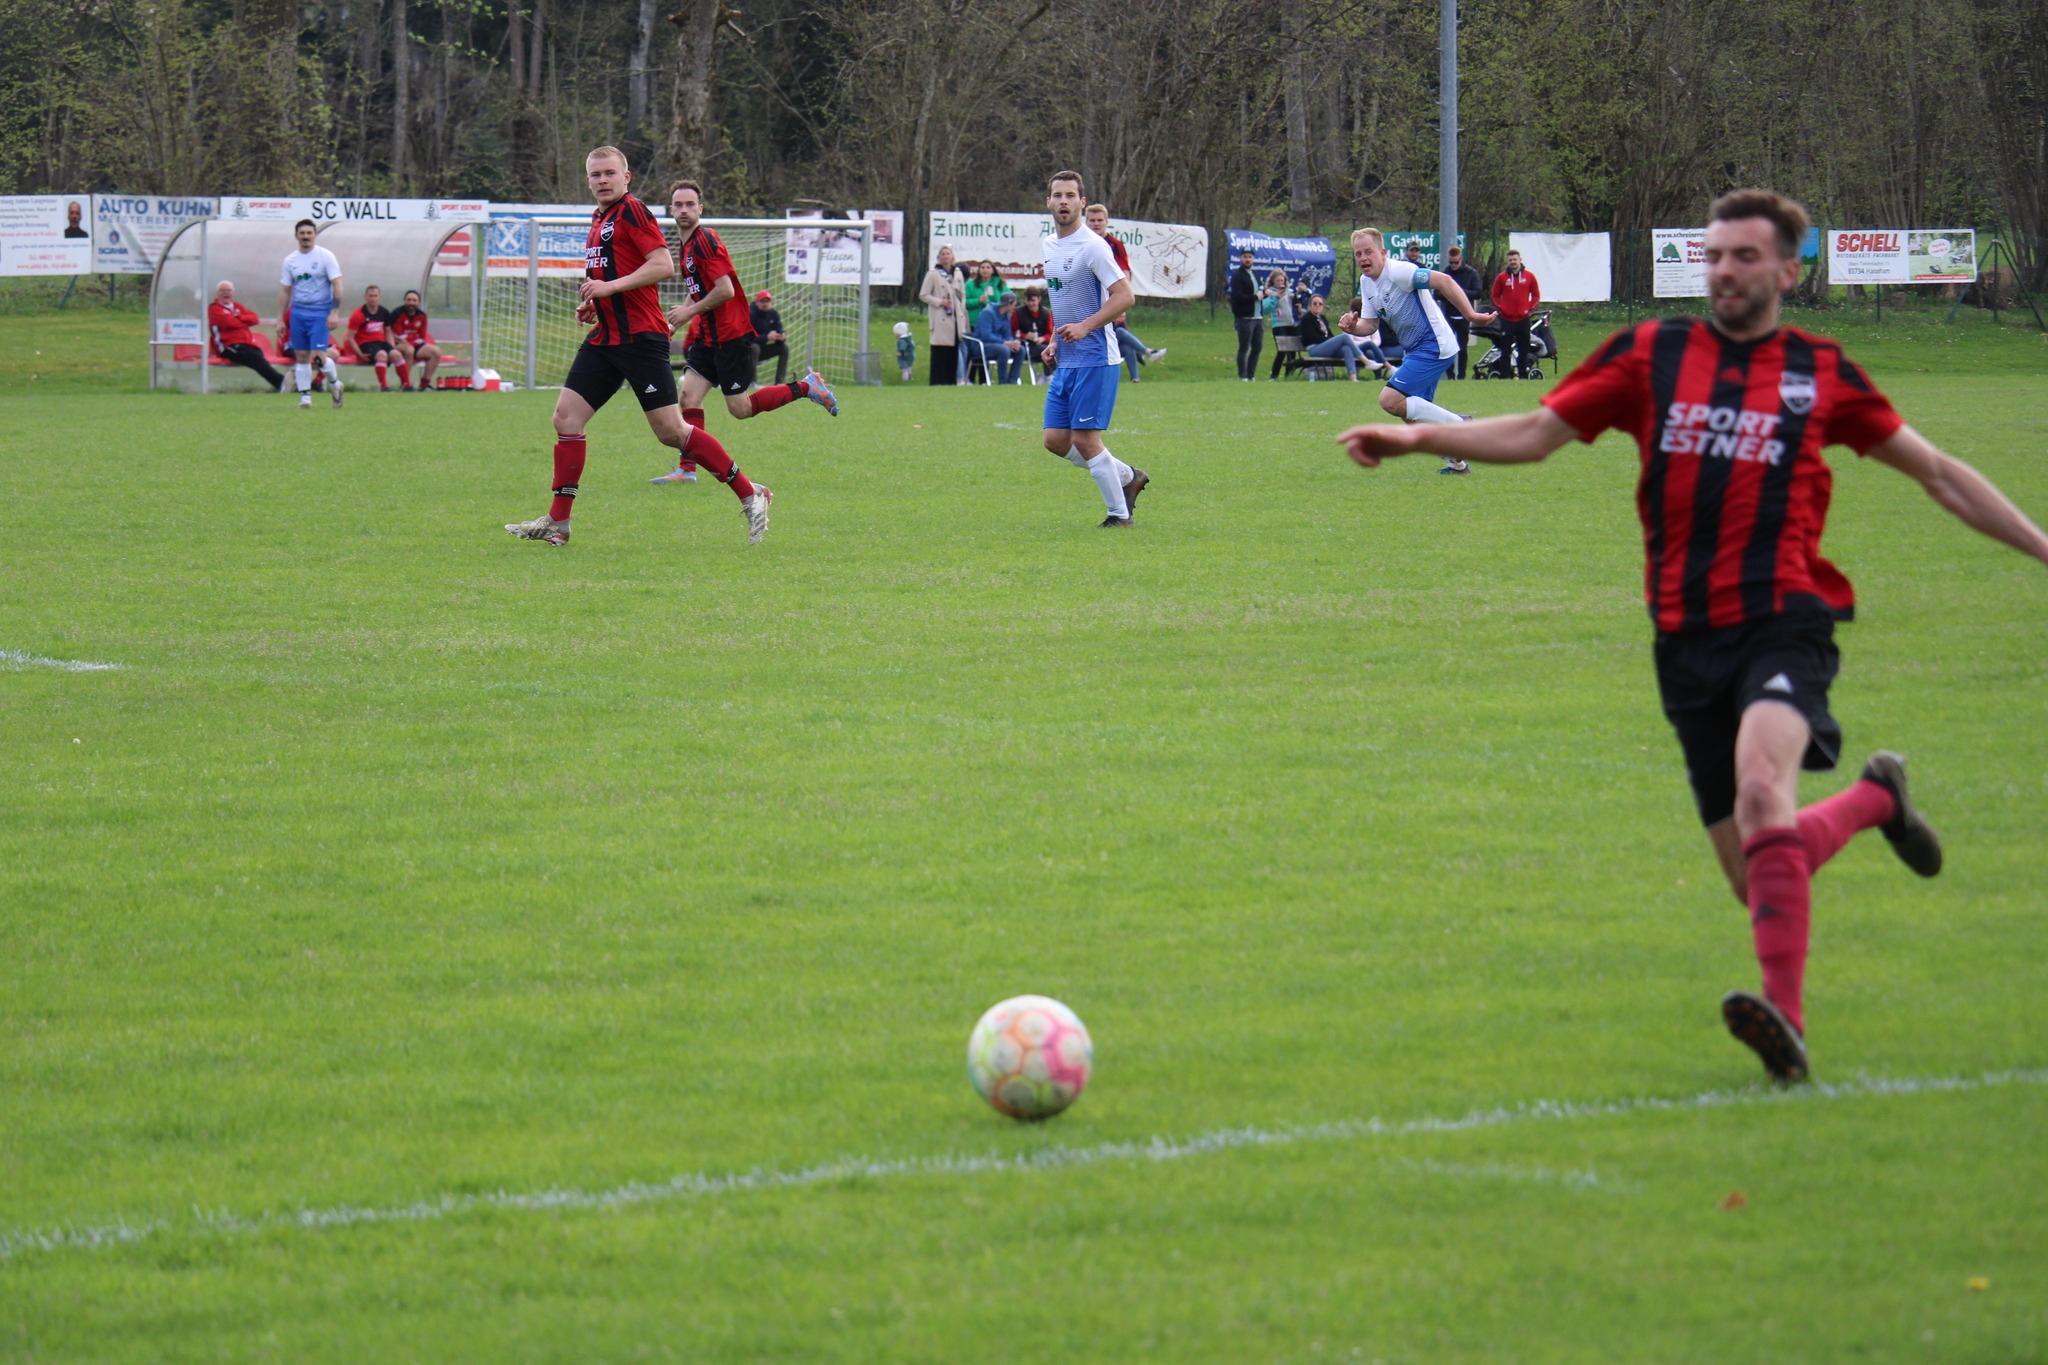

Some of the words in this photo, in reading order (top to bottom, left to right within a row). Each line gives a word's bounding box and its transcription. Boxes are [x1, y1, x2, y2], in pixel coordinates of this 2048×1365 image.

[99, 199, 148, 214] AUTO
[158, 200, 213, 216] KUHN
[311, 200, 337, 219] SC
[344, 201, 397, 220] WALL
[98, 214, 192, 225] MEISTERBETR
[933, 218, 1015, 239] Zimmerei
[1230, 233, 1281, 251] Sportpreise
[1836, 233, 1901, 253] SCHELL
[1665, 401, 1785, 437] SPORT
[1659, 427, 1785, 467] ESTNER
